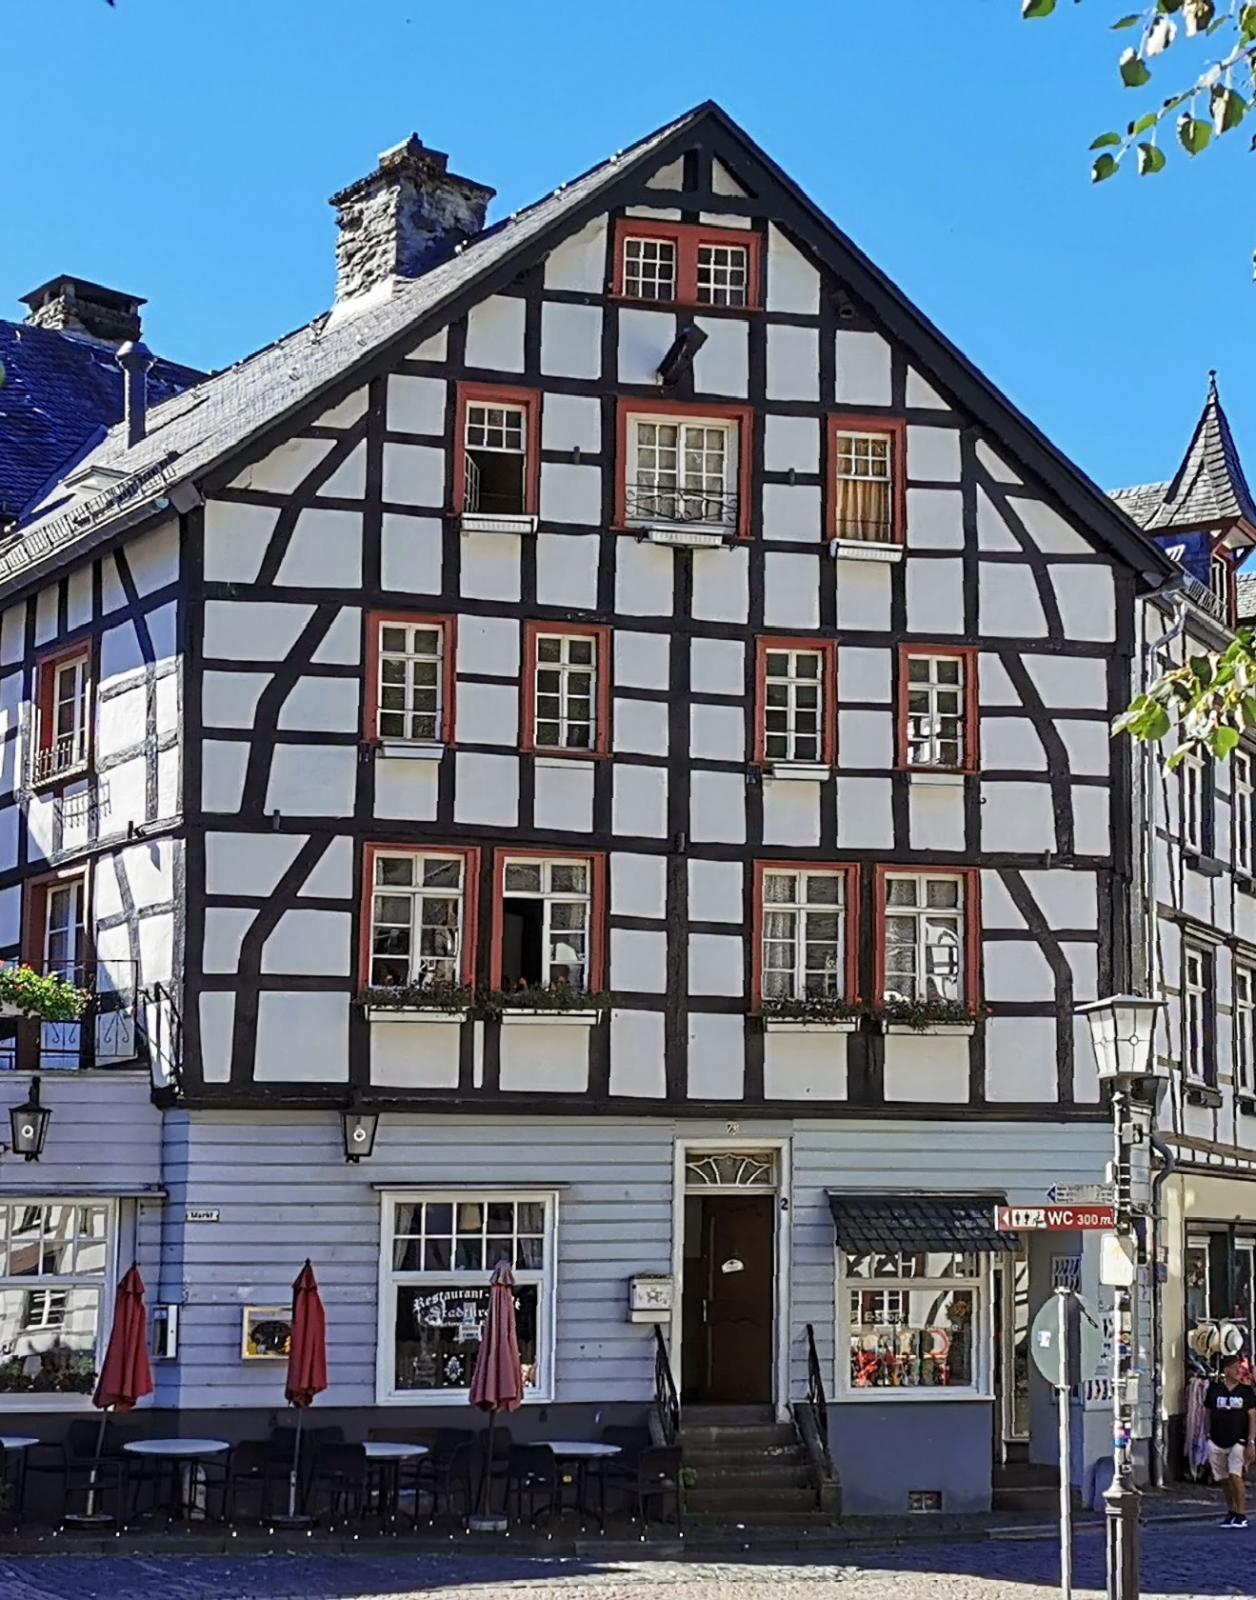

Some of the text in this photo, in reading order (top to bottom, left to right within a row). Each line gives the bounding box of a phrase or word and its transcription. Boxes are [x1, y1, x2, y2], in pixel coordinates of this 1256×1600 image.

[780, 1198, 789, 1211] 2
[1047, 1211, 1073, 1226] WC
[1077, 1214, 1098, 1226] 300
